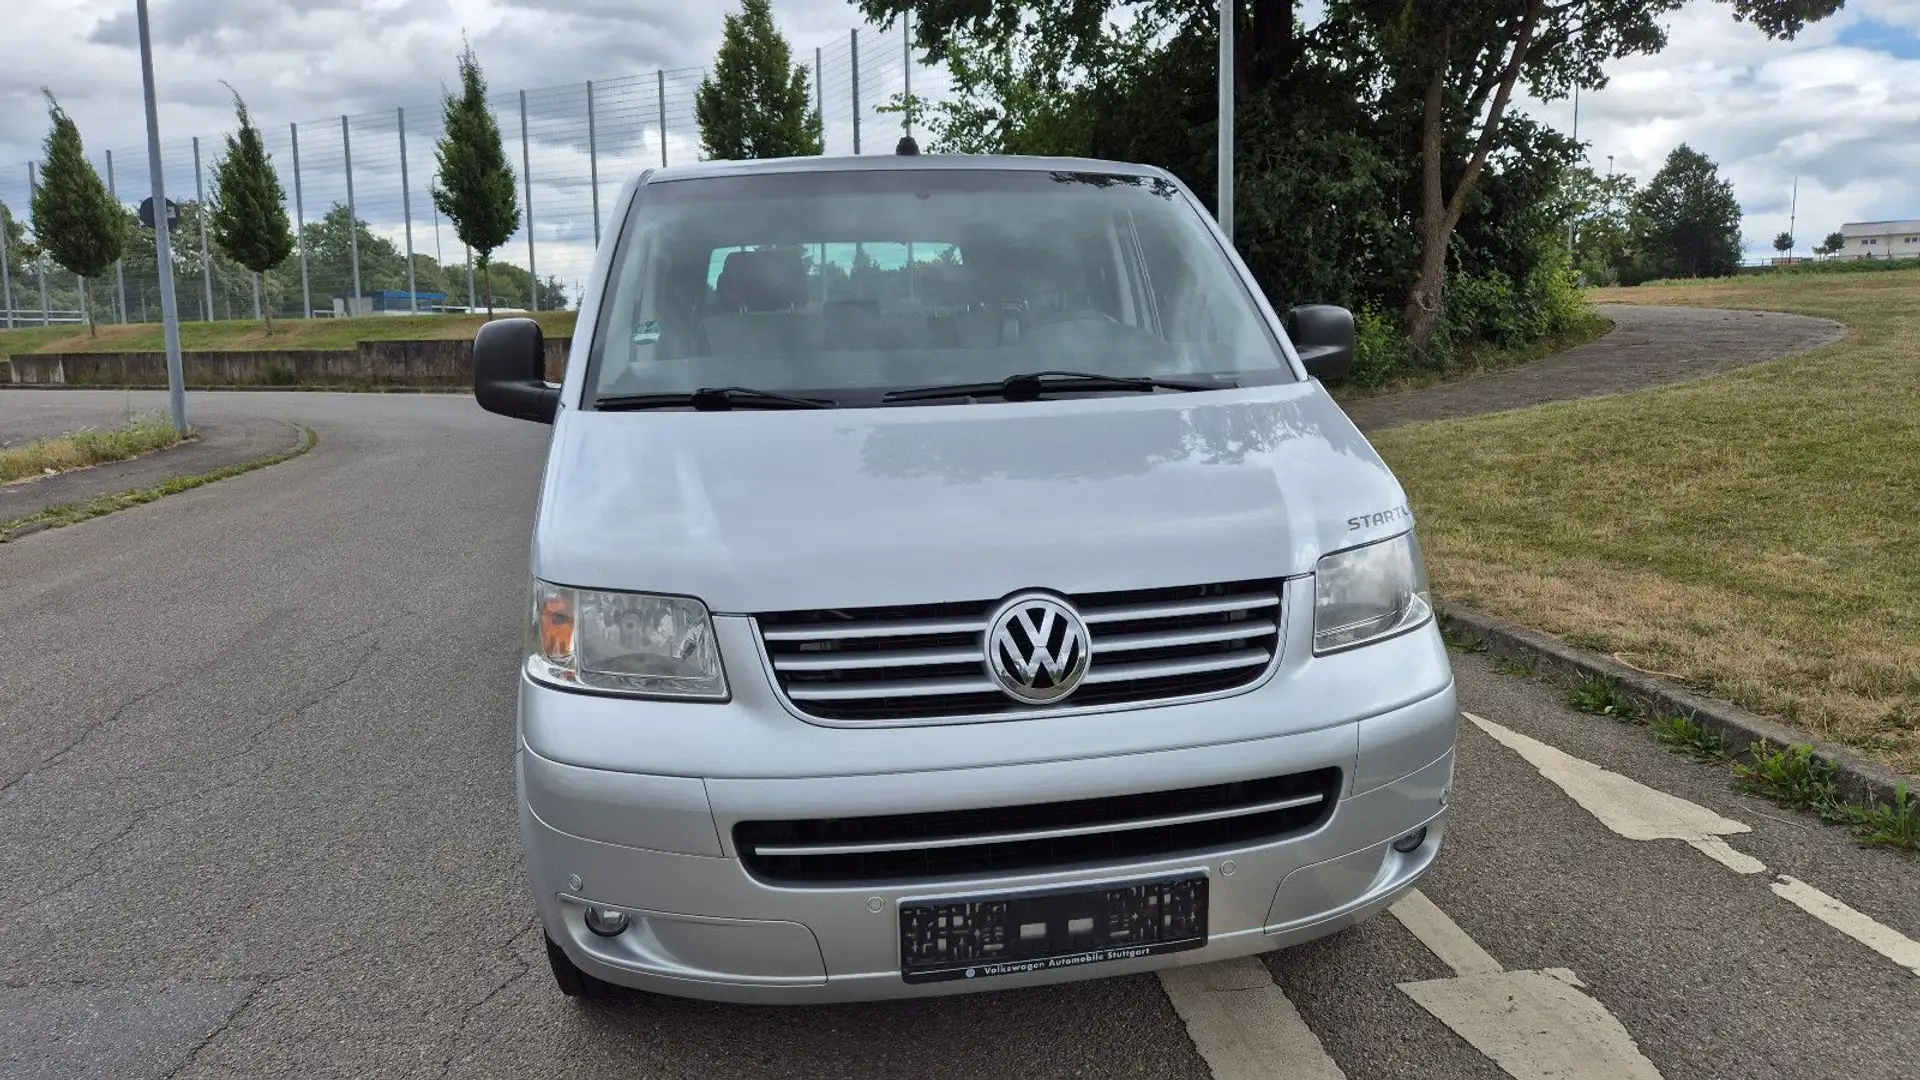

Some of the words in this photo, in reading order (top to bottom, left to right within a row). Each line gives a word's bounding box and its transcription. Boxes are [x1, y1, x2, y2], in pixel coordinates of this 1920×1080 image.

[994, 602, 1084, 696] VW
[984, 962, 1045, 974] Volkswagen
[1048, 952, 1104, 967] Automobile
[1107, 947, 1150, 959] Stuttgart
